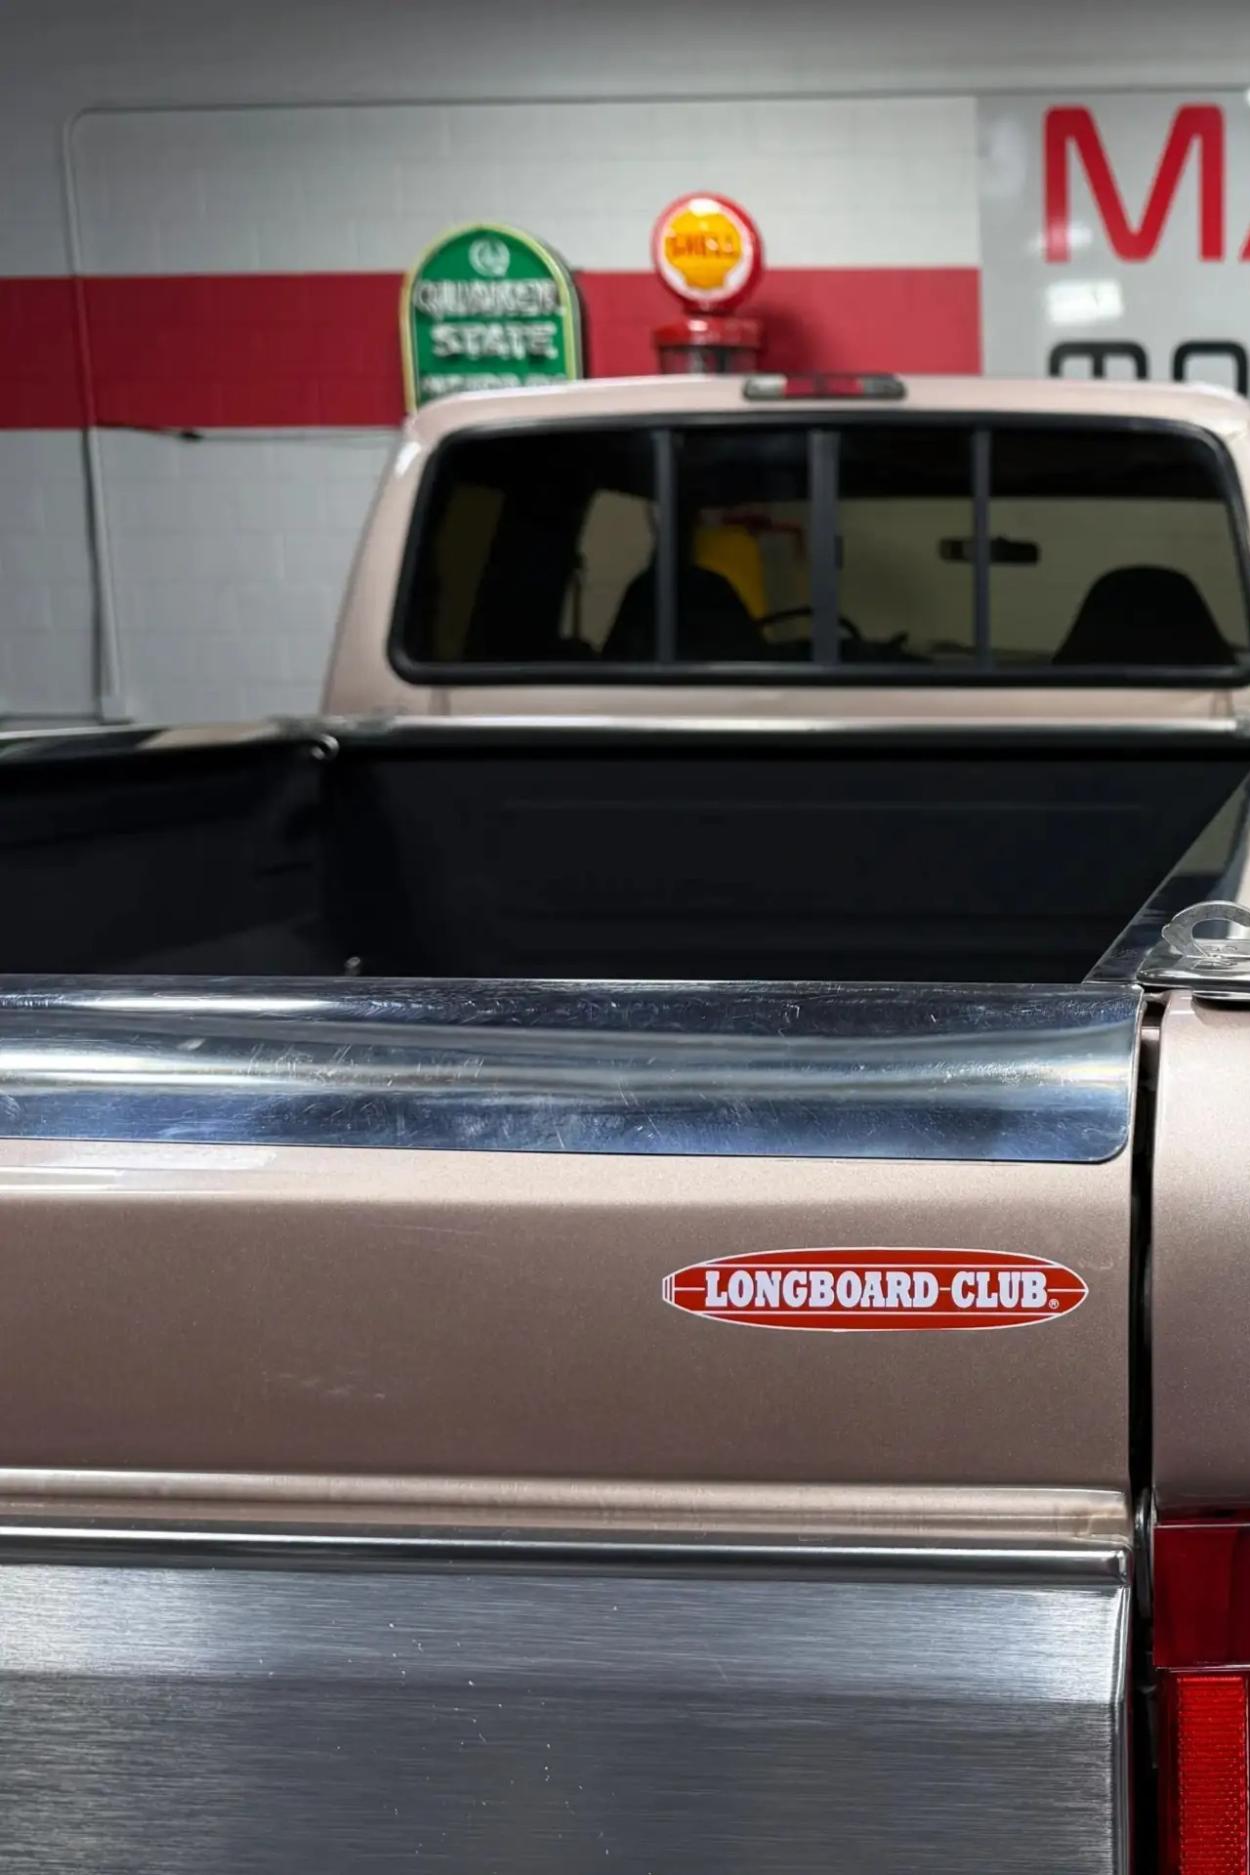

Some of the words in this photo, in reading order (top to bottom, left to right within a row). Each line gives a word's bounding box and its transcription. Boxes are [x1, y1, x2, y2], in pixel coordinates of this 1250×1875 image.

[431, 322, 558, 360] STATE
[704, 1270, 939, 1308] LONGBOARD
[950, 1270, 1048, 1309] CLUB
